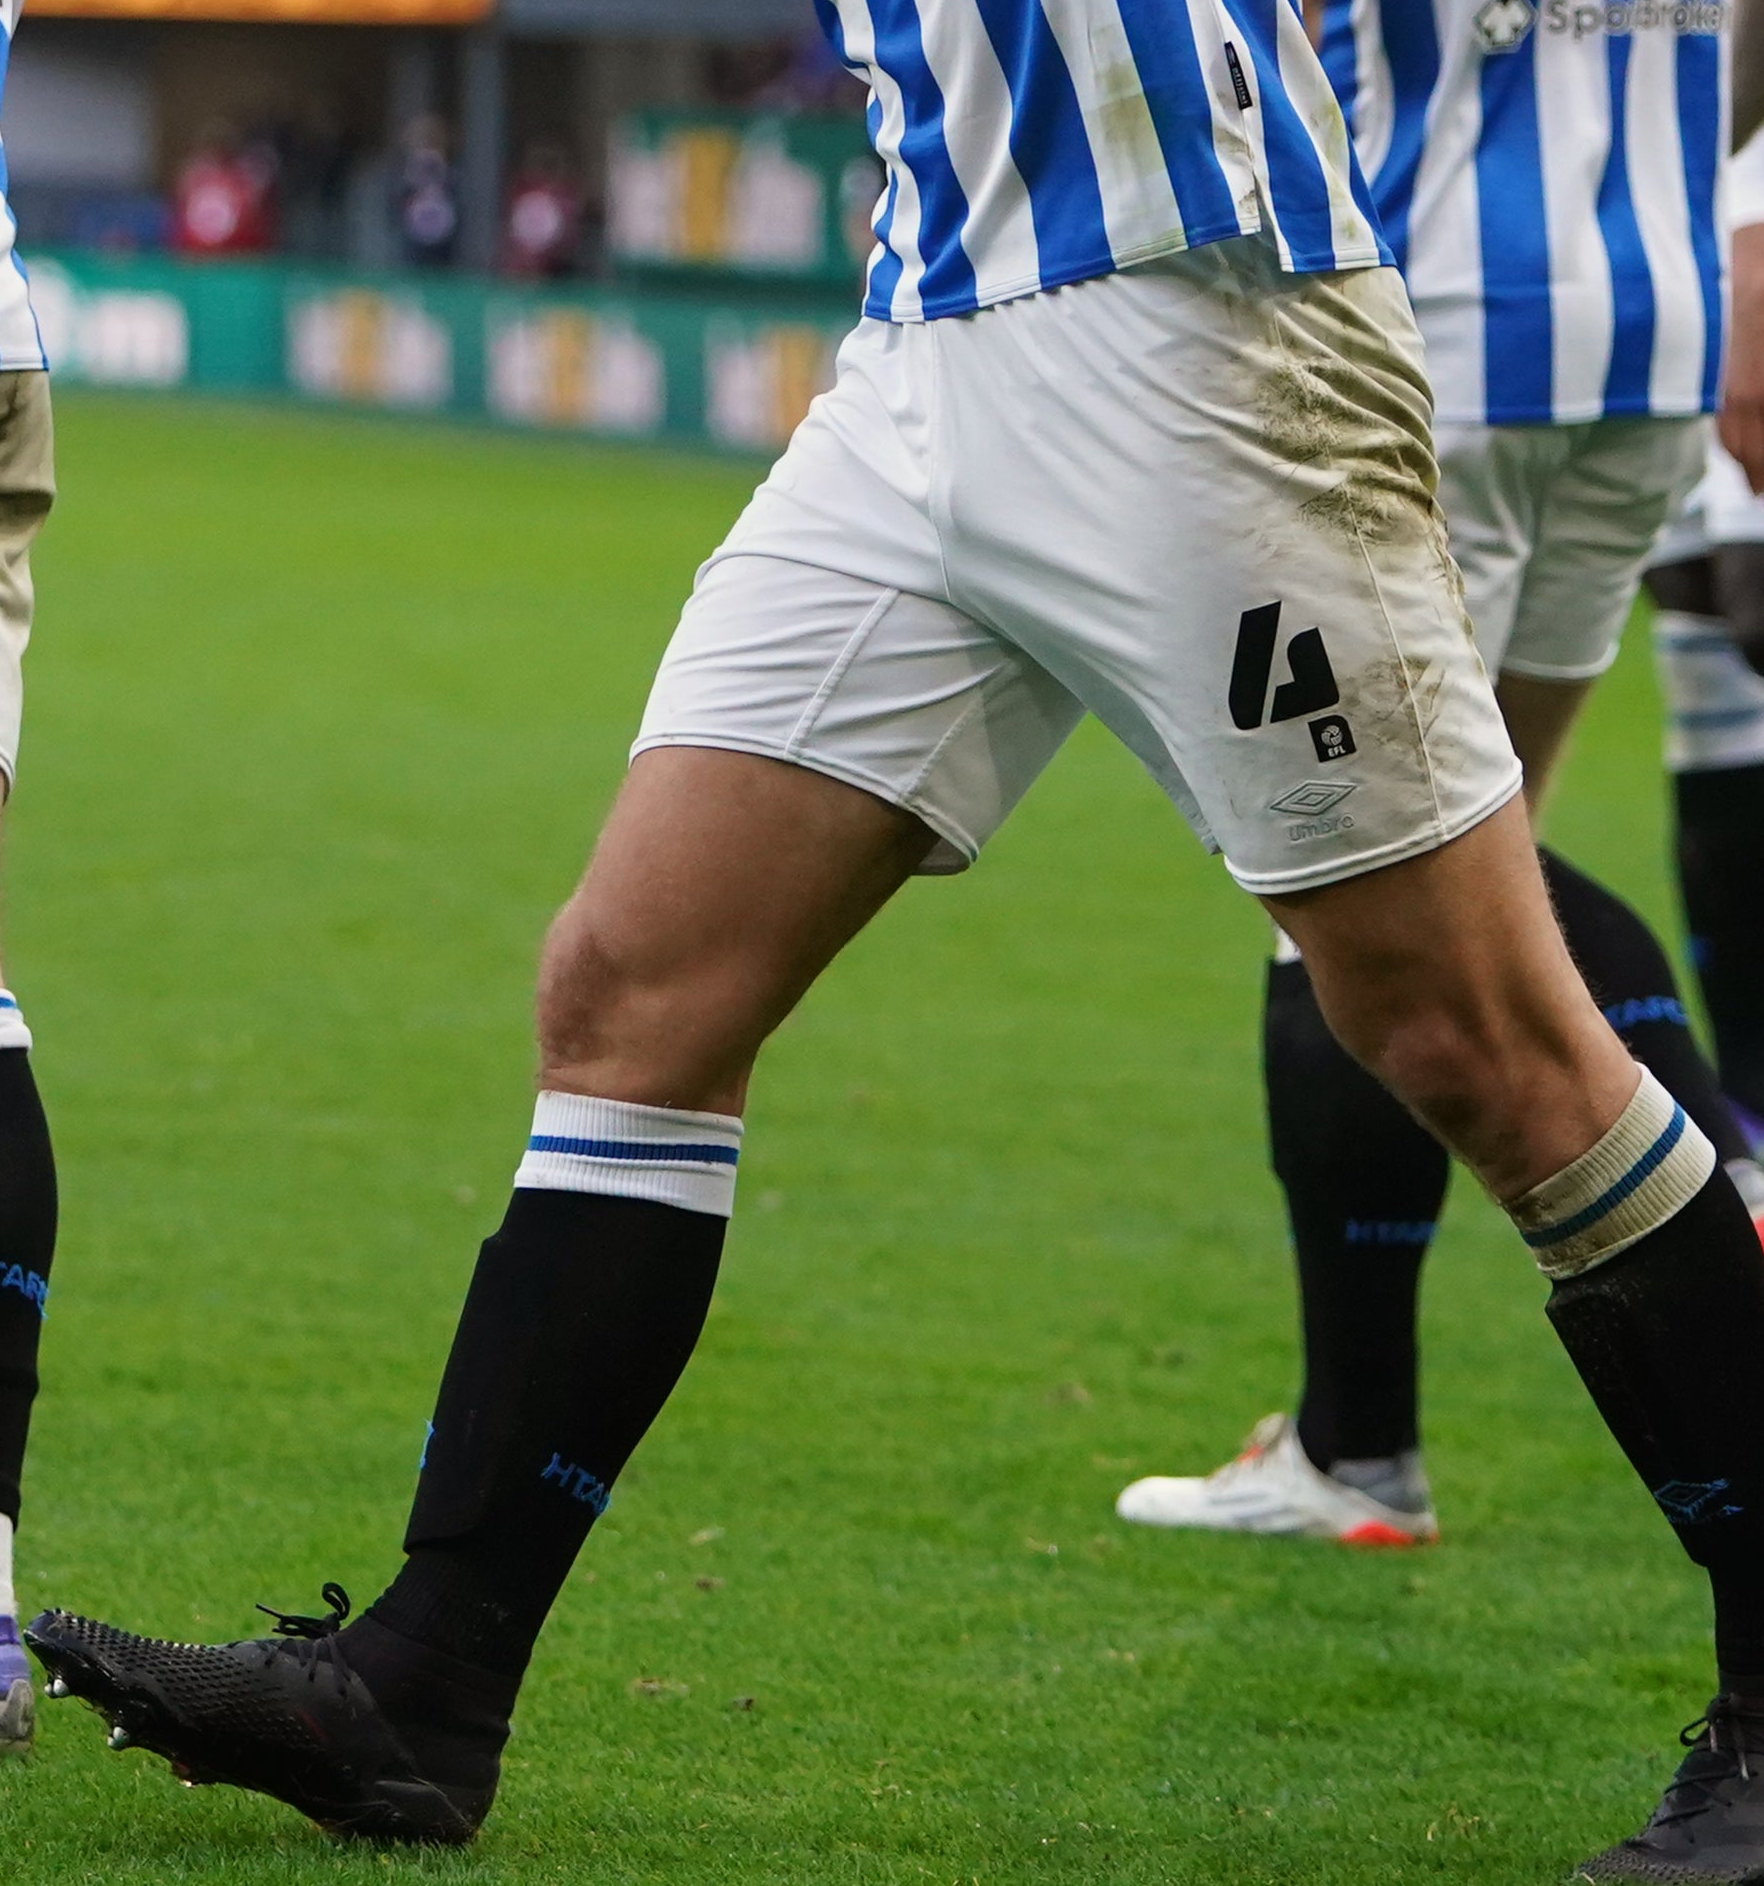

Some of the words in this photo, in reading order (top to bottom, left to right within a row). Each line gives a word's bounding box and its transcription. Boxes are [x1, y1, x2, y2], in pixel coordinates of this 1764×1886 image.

[1228, 600, 1340, 731] 4
[1327, 745, 1347, 757] EFL
[1285, 813, 1356, 843] umbro
